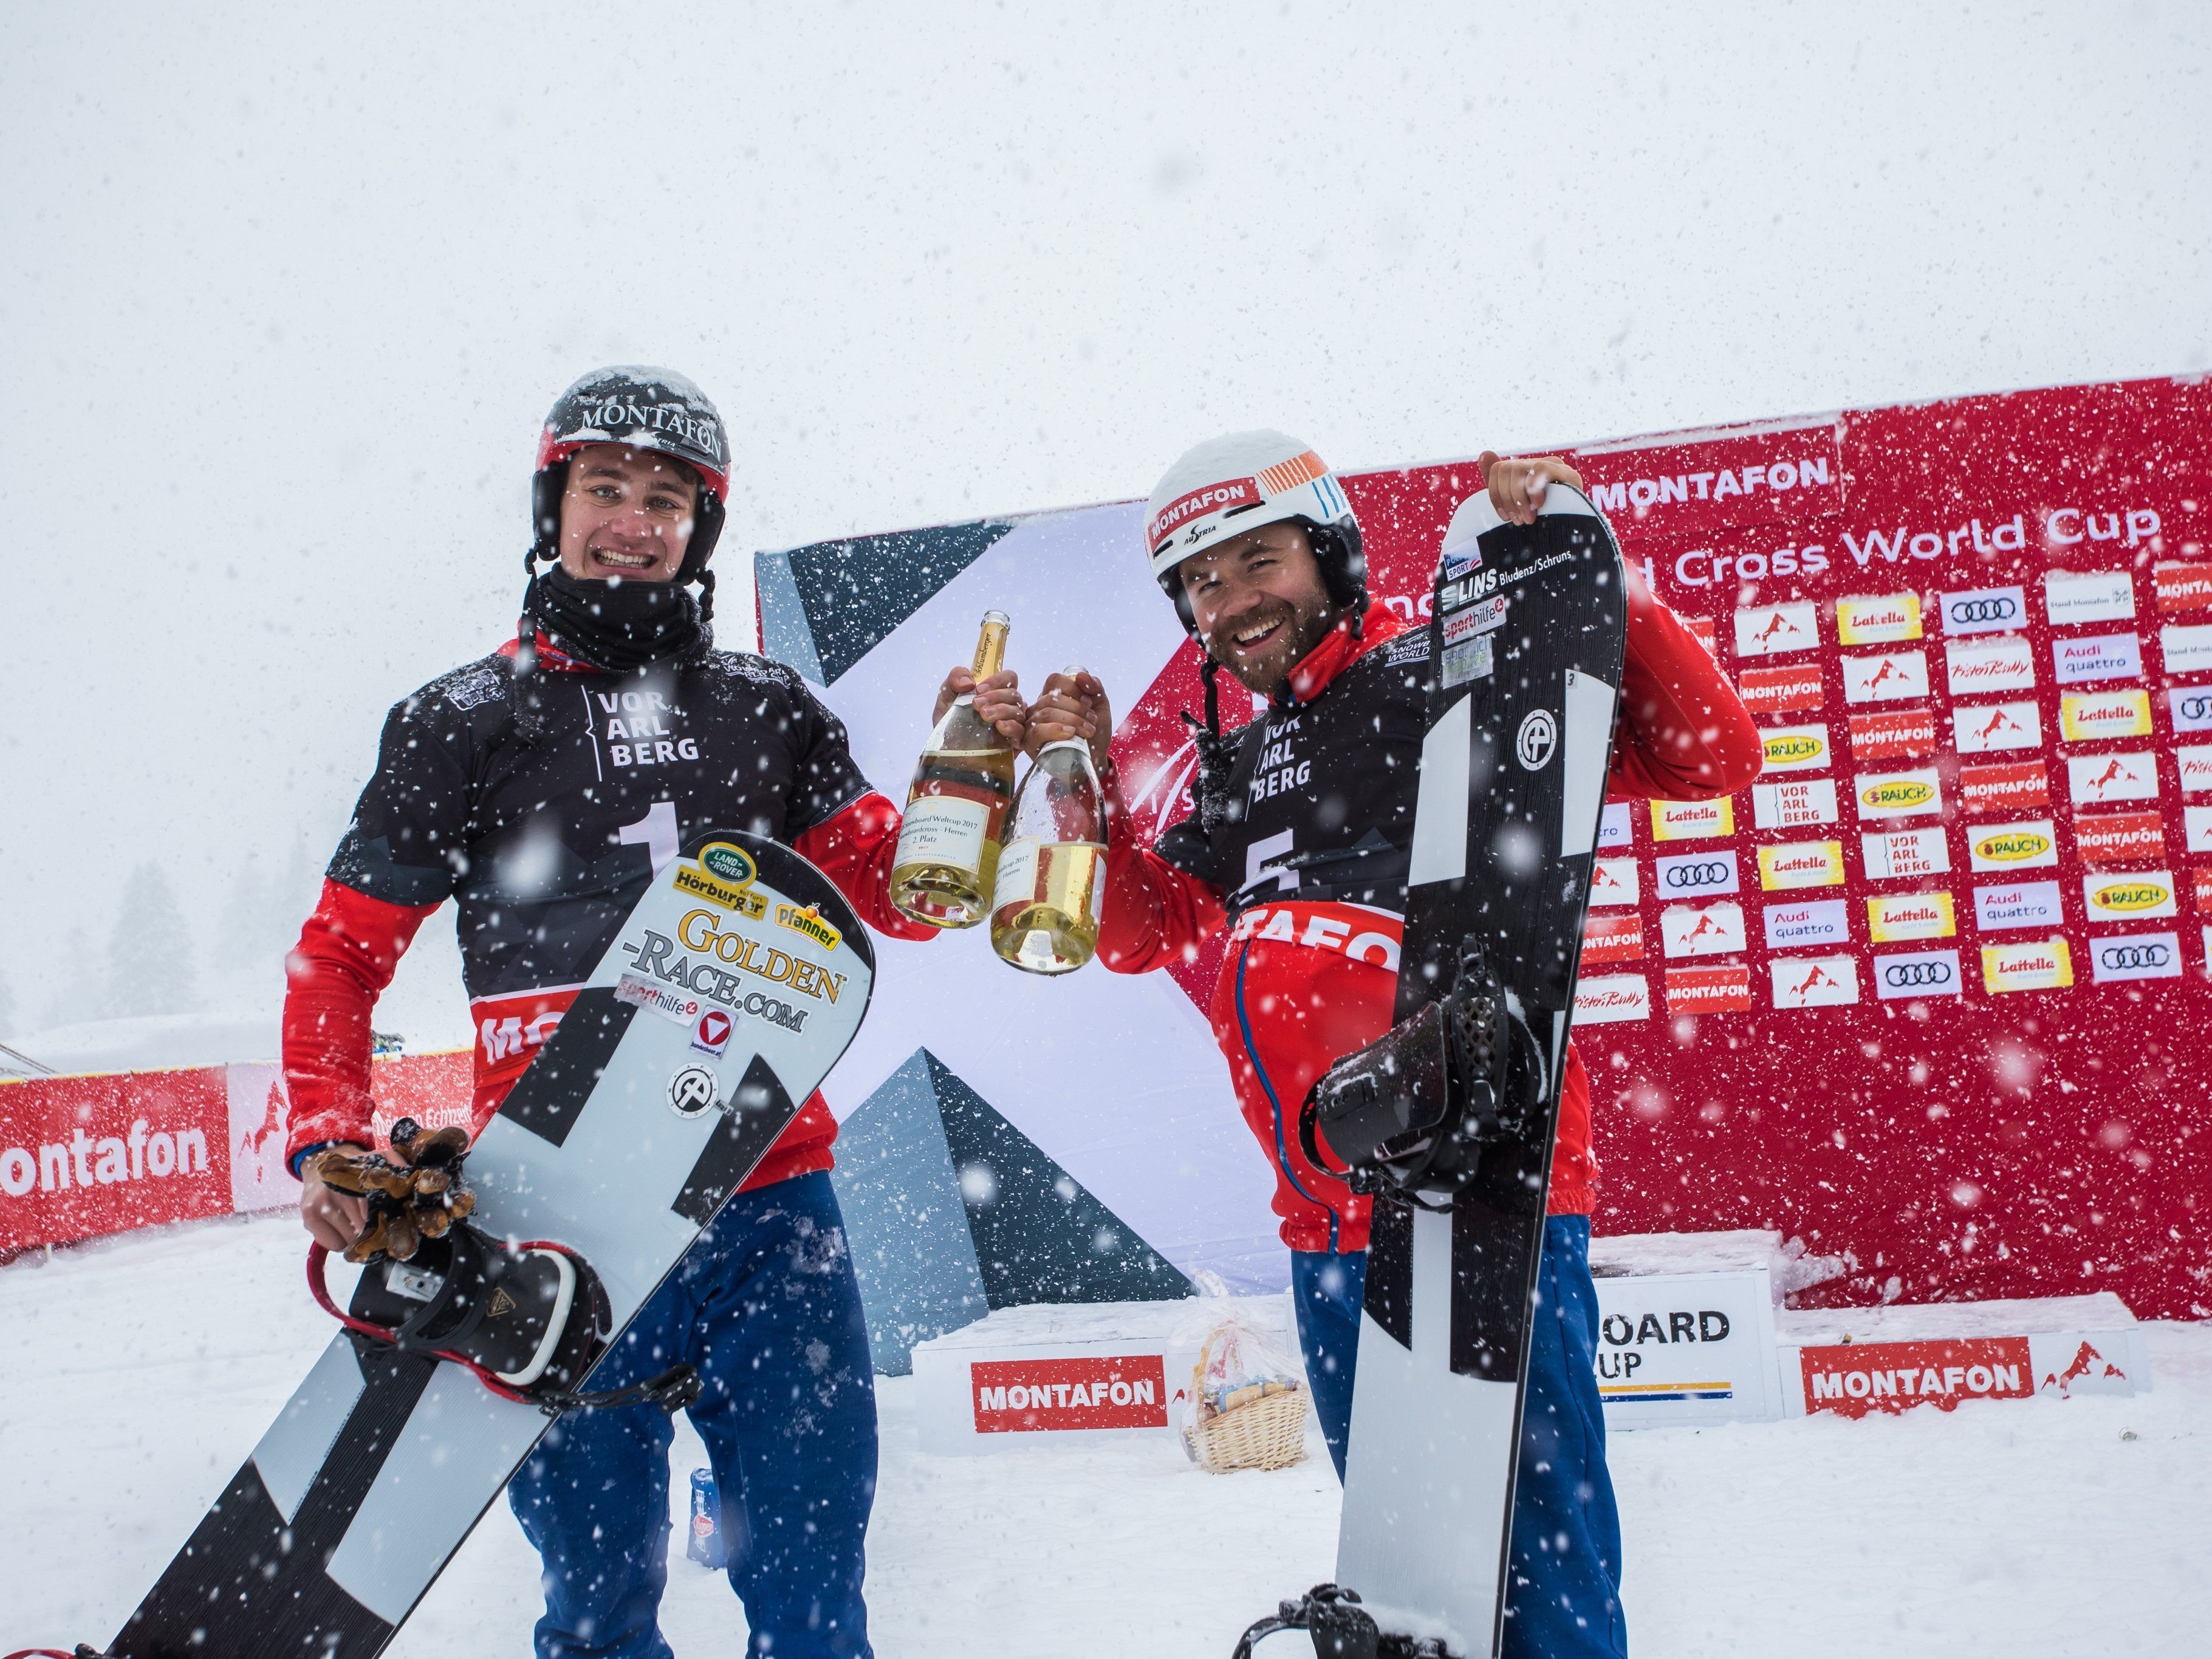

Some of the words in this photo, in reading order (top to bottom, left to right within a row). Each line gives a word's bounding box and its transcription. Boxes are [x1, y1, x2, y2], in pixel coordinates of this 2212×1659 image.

[581, 404, 722, 463] MONTAFON
[1591, 457, 1829, 511] MONTAFON
[1152, 484, 1245, 539] MONTAFON
[1184, 524, 1216, 546] AUSTRIA
[1675, 545, 1828, 587] Cross
[1841, 514, 2025, 566] World
[2046, 508, 2161, 547] Cup
[1449, 562, 1469, 578] SPORT
[1459, 568, 1497, 603] LINS
[1499, 550, 1572, 586] Bludenz/Schruns
[1445, 606, 1496, 640] sporthilfe
[1851, 611, 1906, 628] Latella
[974, 632, 993, 678] Schlumberger
[1388, 646, 1430, 662] WORLD
[2064, 644, 2101, 658] Audi
[2065, 657, 2126, 674] quattro
[1742, 681, 1821, 700] MONTAFON
[597, 691, 668, 714] VOR
[607, 717, 670, 740] ARL
[1851, 727, 1934, 745] MONTAFON
[611, 737, 699, 768] BERG
[1771, 741, 1815, 756] RAUCH
[1259, 739, 1295, 776] ARL
[1254, 759, 1311, 804] BERG
[1964, 778, 2047, 797] MONTAFON
[1780, 786, 1809, 798] VOR
[1881, 787, 1926, 802] RAUCH
[1782, 799, 1809, 809] ARL
[933, 816, 961, 826] Weltcup
[962, 820, 978, 830] 2017
[1665, 807, 1718, 823] Lattella
[1784, 810, 1820, 823] BERG
[944, 826, 968, 837] Herren
[2077, 830, 2163, 847] MONTAFON
[619, 801, 680, 879] 1
[1890, 835, 1919, 847] VOR
[1995, 839, 2043, 854] RAUCH
[713, 852, 739, 866] LAND
[1015, 855, 1029, 864] 2017
[1892, 849, 1919, 861] ARL
[712, 862, 743, 878] ROVER
[1773, 856, 1827, 872] Lattella
[1894, 860, 1931, 873] BERG
[1002, 868, 1021, 880] Herren
[676, 871, 764, 913] Hörburger
[739, 889, 764, 903] Wolfurt
[1985, 892, 2022, 905] Audi
[2112, 889, 2160, 904] RAUCH
[1774, 911, 1809, 923] Audi
[1883, 908, 1938, 923] Lattella
[1987, 905, 2047, 920] quattro
[1776, 924, 1834, 939] quattro
[677, 908, 849, 1005] GOLDEN
[1998, 957, 2055, 973] Lattella
[617, 980, 685, 1016] sporthilfe
[1668, 983, 1748, 1000] MONTAFON
[1603, 1310, 1731, 1346] OARD
[1595, 1352, 1642, 1379] UP
[1812, 1363, 2021, 1400] MONTAFON
[979, 1380, 1155, 1411] MONTAFON
